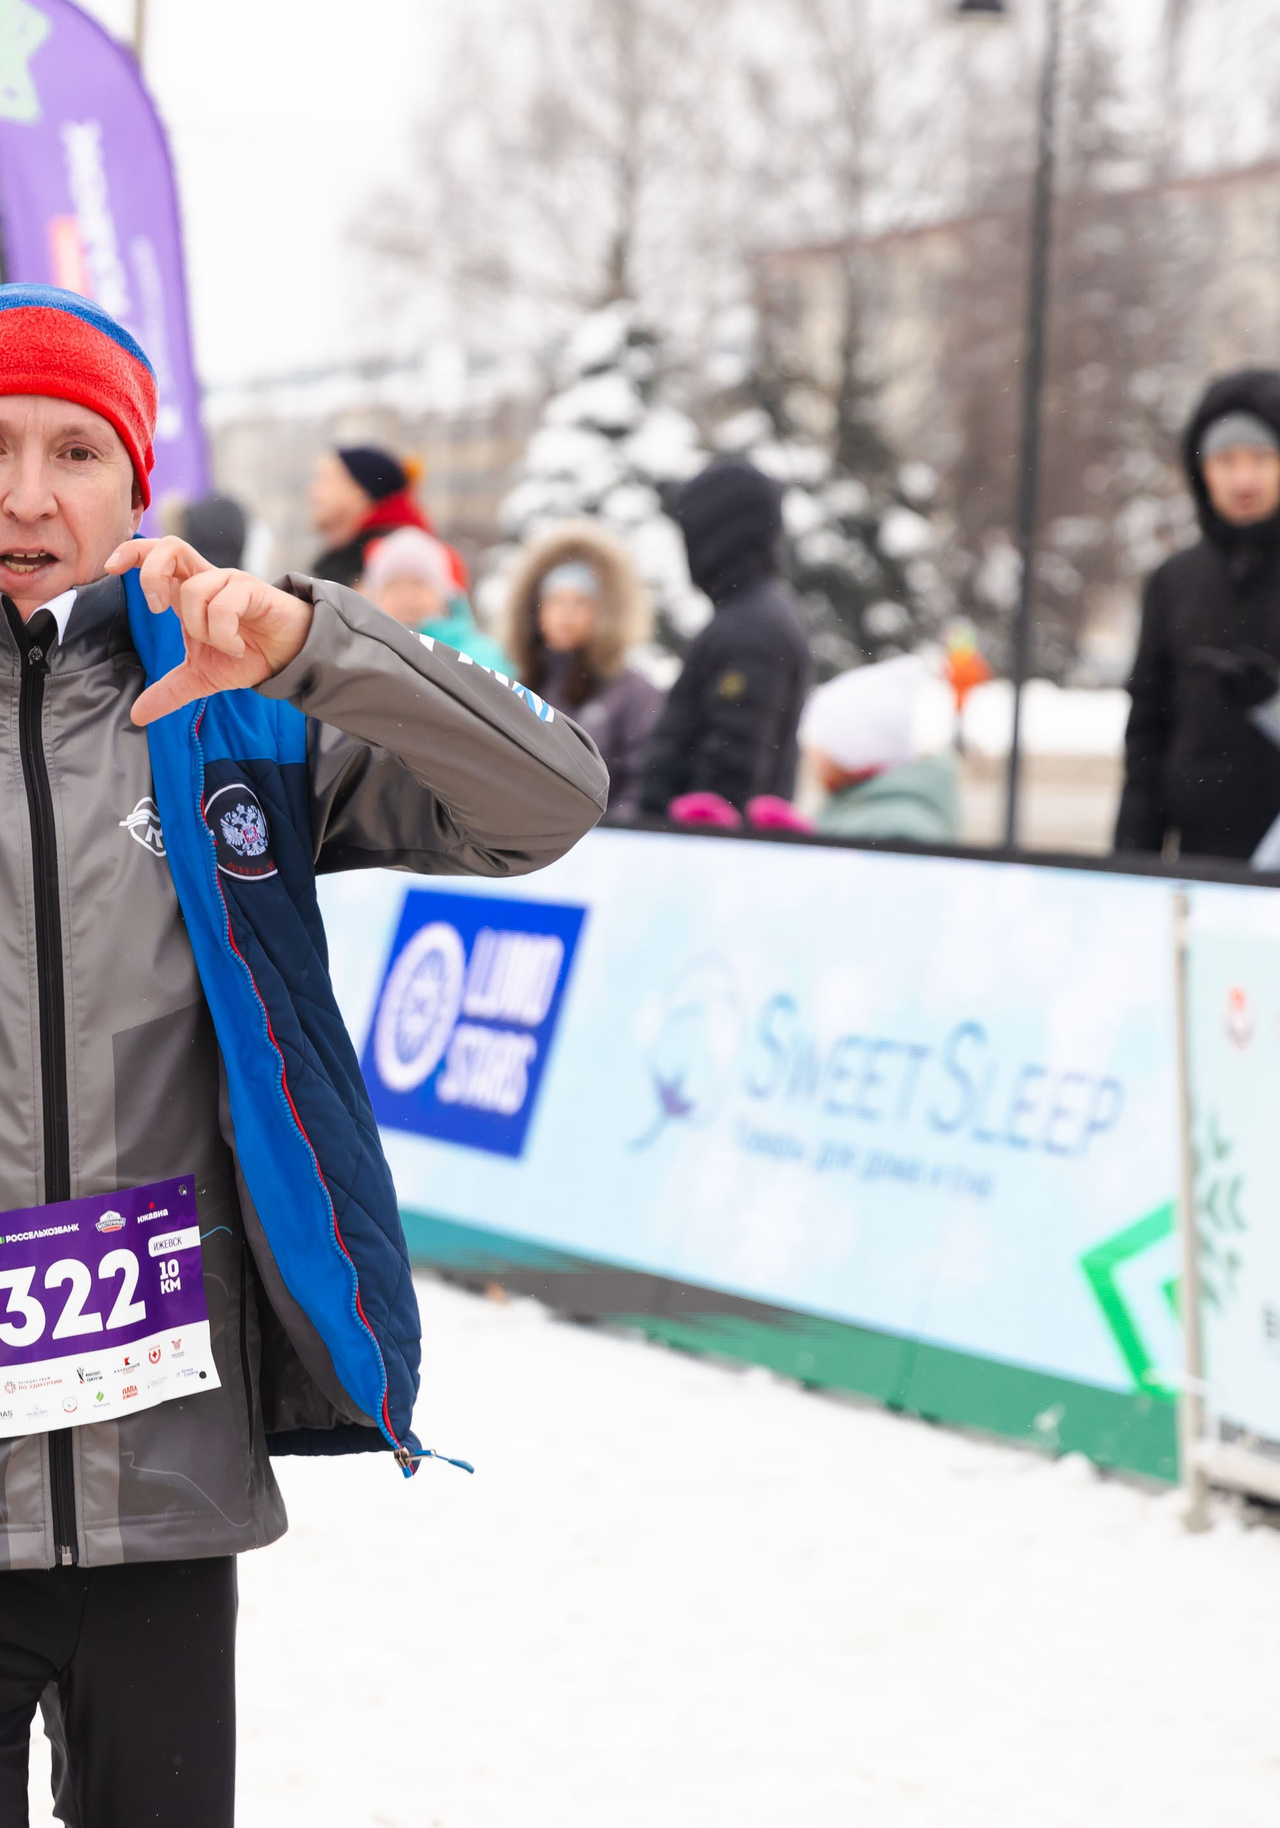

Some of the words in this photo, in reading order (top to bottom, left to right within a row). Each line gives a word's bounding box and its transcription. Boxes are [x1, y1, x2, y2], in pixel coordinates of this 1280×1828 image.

[5, 1223, 80, 1243] РОССЕЛЬХОЗБАНК
[153, 1236, 182, 1251] ИЖЕВСК
[159, 1259, 179, 1280] 10
